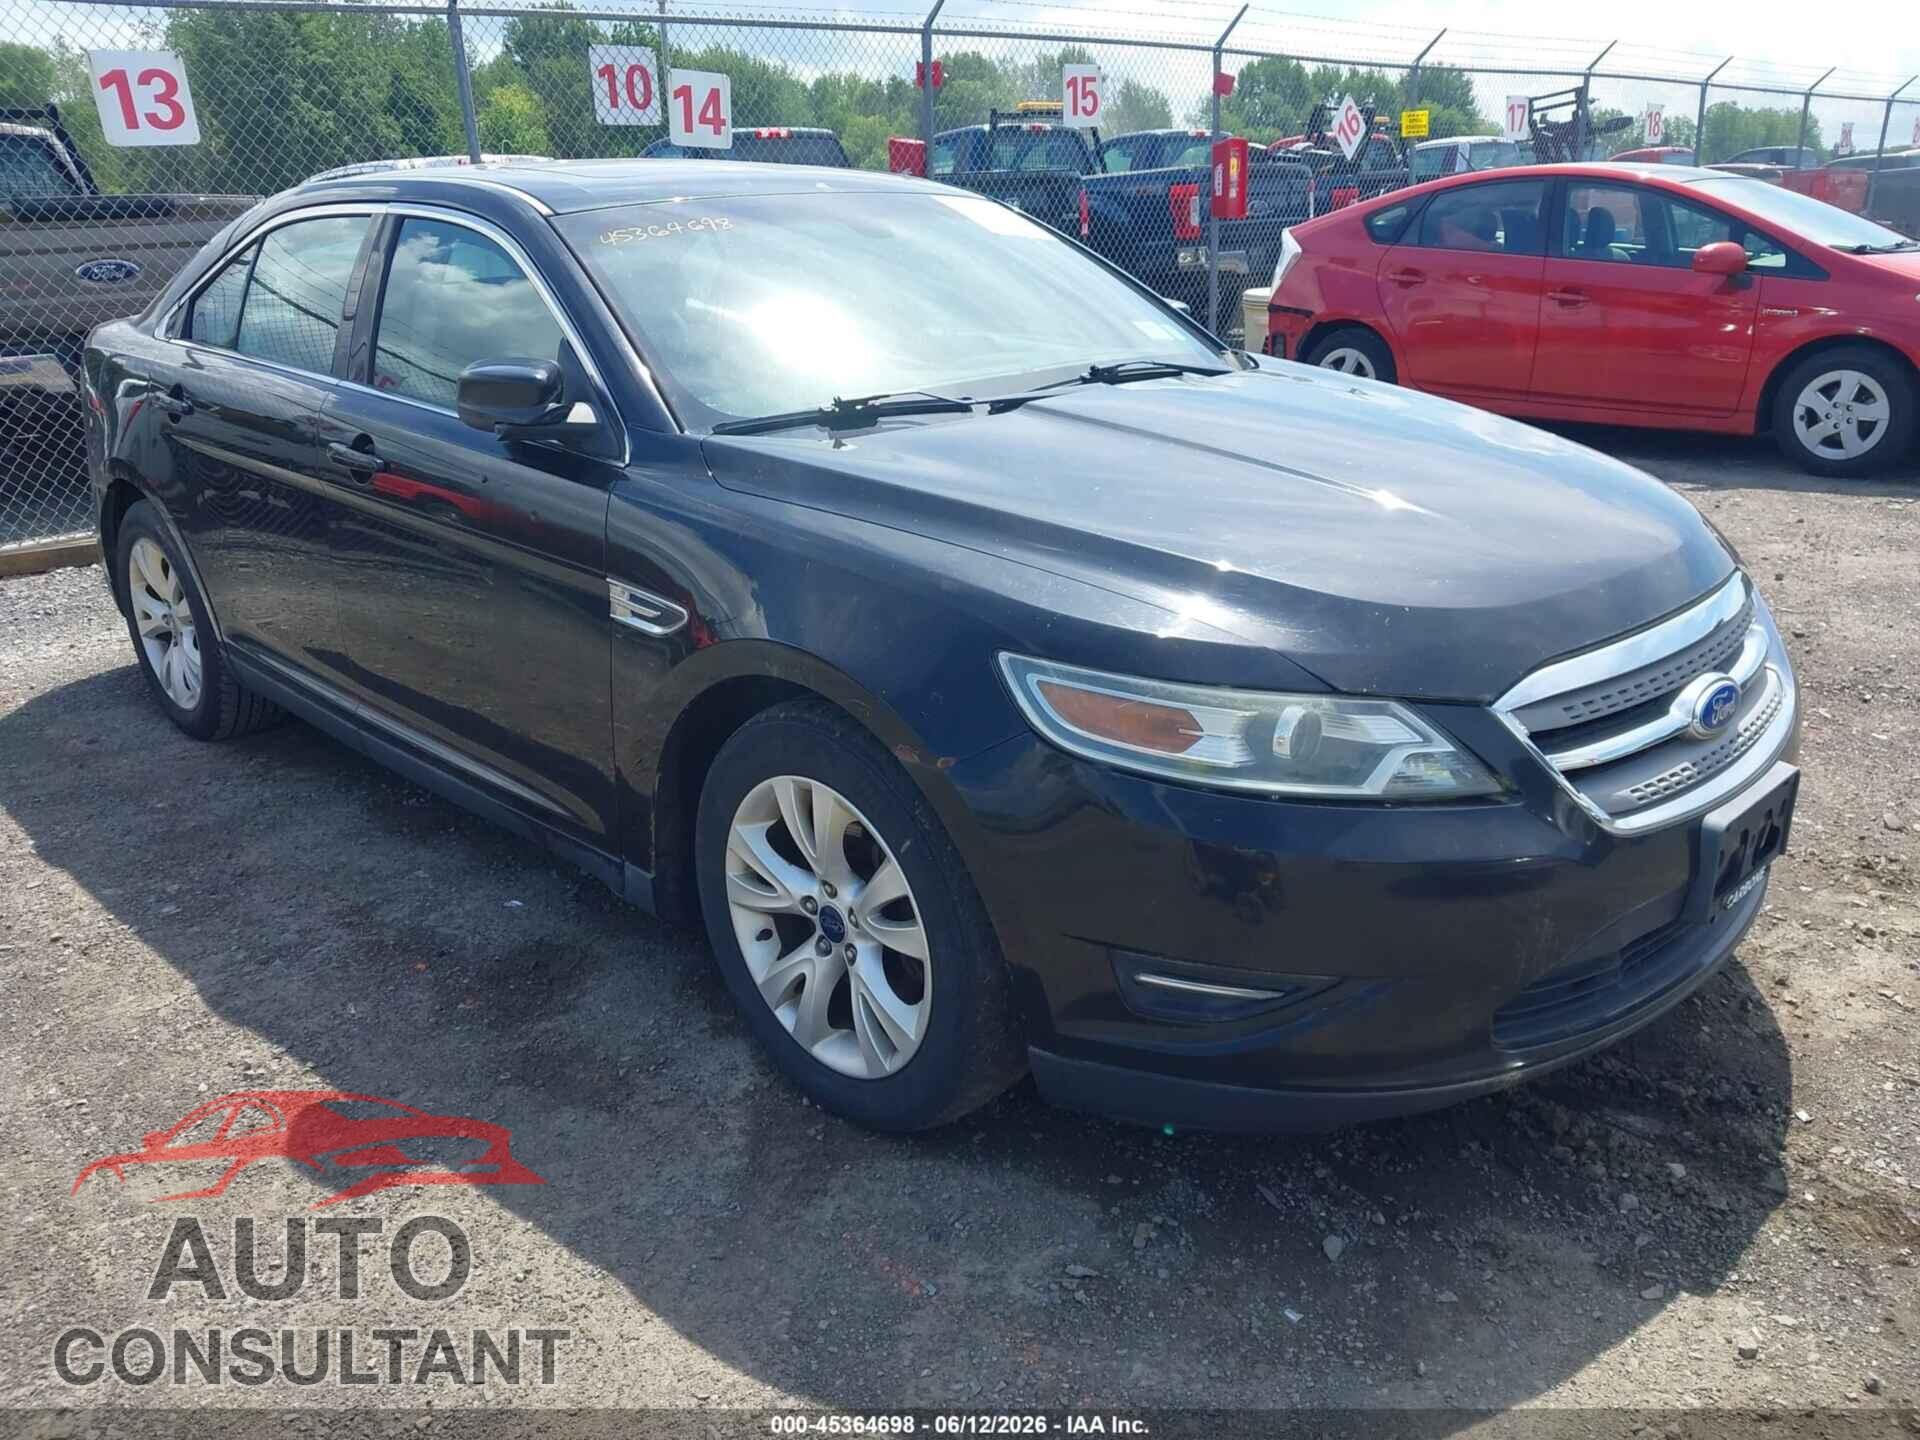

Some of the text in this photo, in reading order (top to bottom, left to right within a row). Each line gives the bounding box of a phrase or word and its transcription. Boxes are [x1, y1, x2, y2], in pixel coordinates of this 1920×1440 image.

[98, 67, 186, 131] 13
[597, 63, 653, 111] 10
[1066, 75, 1099, 117] 15
[673, 84, 727, 136] 14
[1337, 104, 1361, 146] 16
[1507, 103, 1527, 133] 17
[1647, 111, 1662, 137] 18
[599, 216, 735, 246] 45364698
[1711, 689, 1737, 725] Ford
